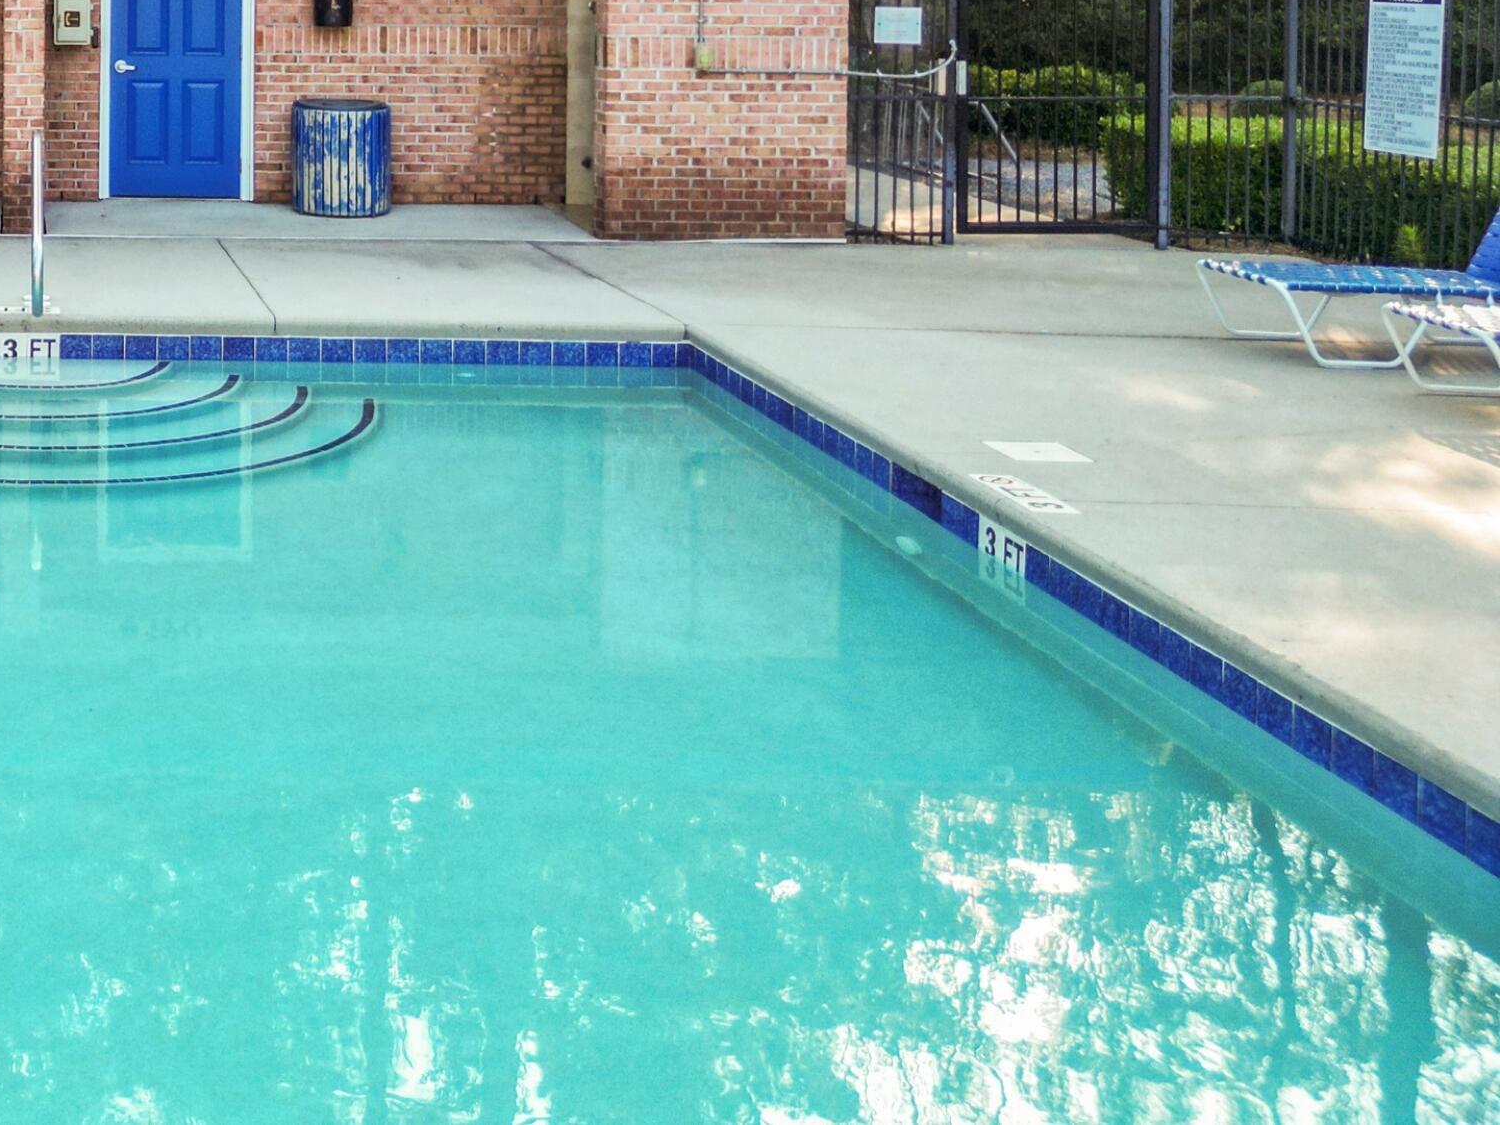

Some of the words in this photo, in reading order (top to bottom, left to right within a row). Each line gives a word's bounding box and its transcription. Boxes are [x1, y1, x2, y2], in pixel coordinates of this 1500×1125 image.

[3, 338, 18, 359] 3
[30, 338, 56, 359] FT
[985, 527, 996, 556] 3
[1003, 536, 1024, 572] FT
